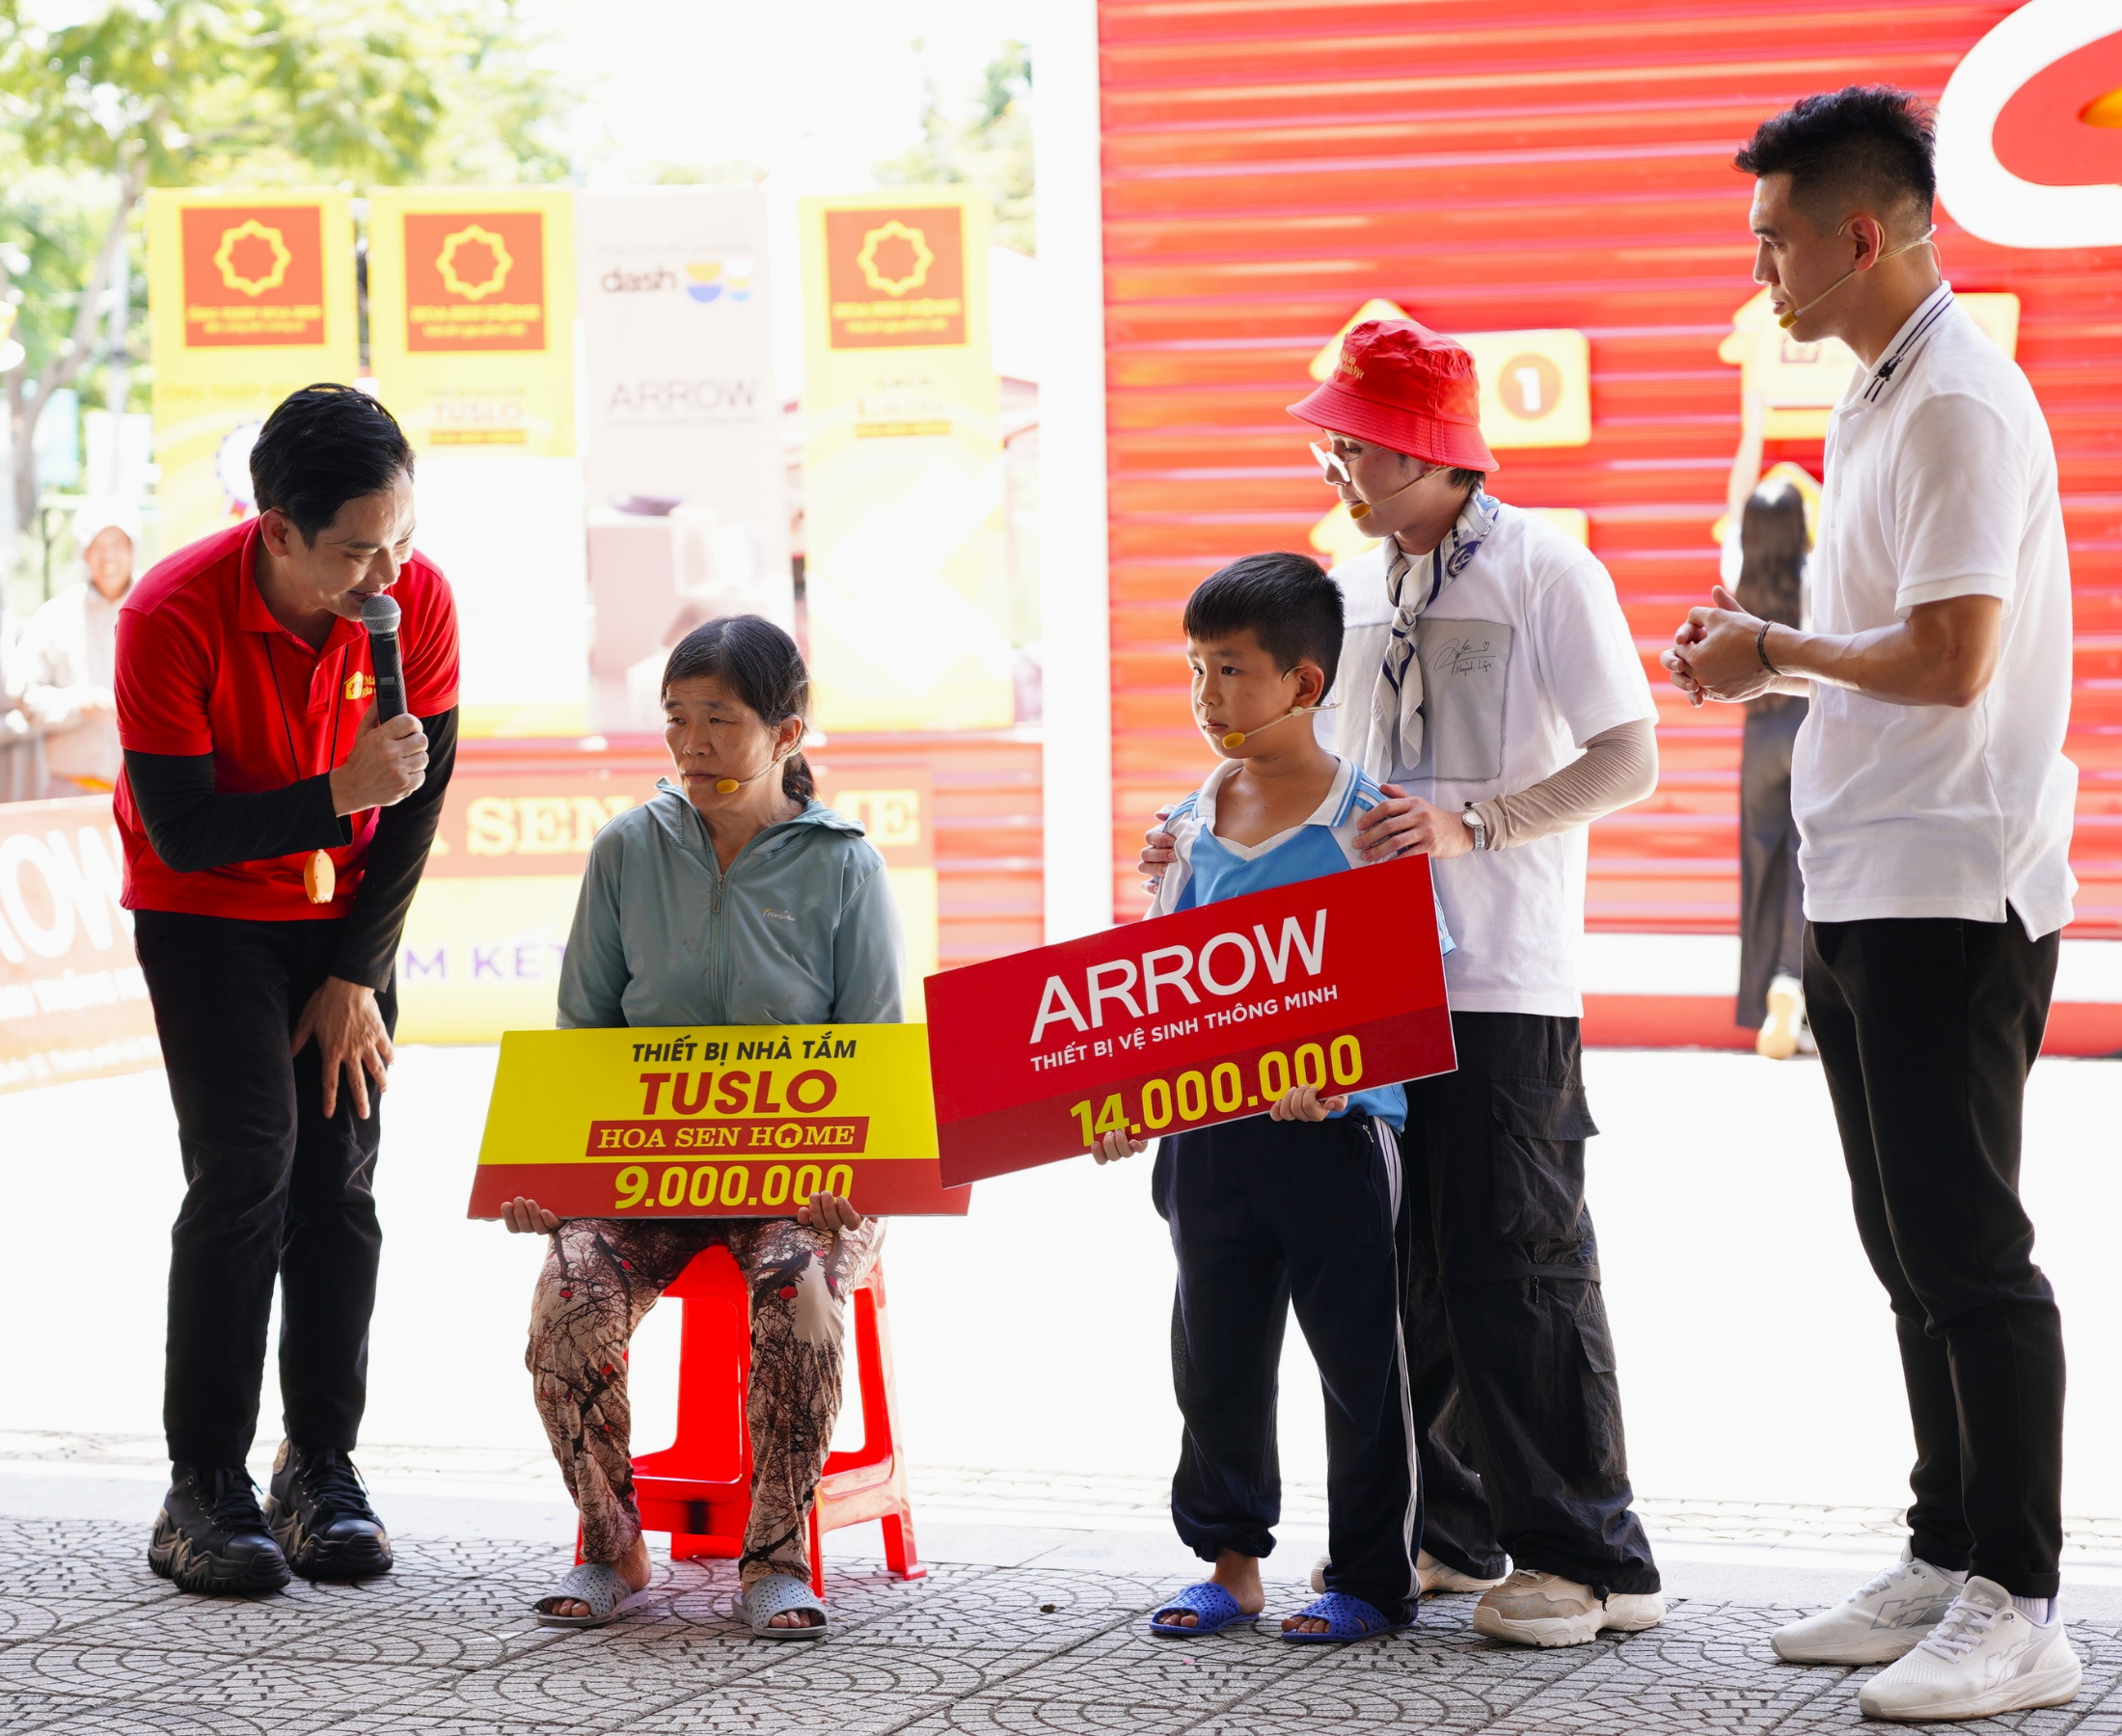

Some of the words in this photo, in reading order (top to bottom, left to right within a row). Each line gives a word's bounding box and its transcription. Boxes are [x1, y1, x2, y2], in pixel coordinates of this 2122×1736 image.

[1513, 367, 1542, 412] 1
[1028, 909, 1328, 1044] ARROW
[632, 1034, 697, 1063] THIẾT
[704, 1041, 728, 1066] BỊ
[735, 1037, 792, 1061] NHÀ
[802, 1030, 857, 1059] TẮM
[1030, 1039, 1089, 1071] THIẾT
[1093, 1038, 1114, 1059] BỊ
[1118, 1027, 1148, 1050] VỆ
[1152, 1017, 1200, 1042] SINH
[1204, 997, 1279, 1029] THÔNG
[1285, 985, 1339, 1009] MINH
[638, 1069, 838, 1116] TUSLO
[1069, 1034, 1364, 1148] 14.000.000
[596, 1127, 667, 1149] HOA
[675, 1126, 742, 1148] SEN
[748, 1123, 856, 1148] HOME
[614, 1163, 854, 1210] 9.000.000
